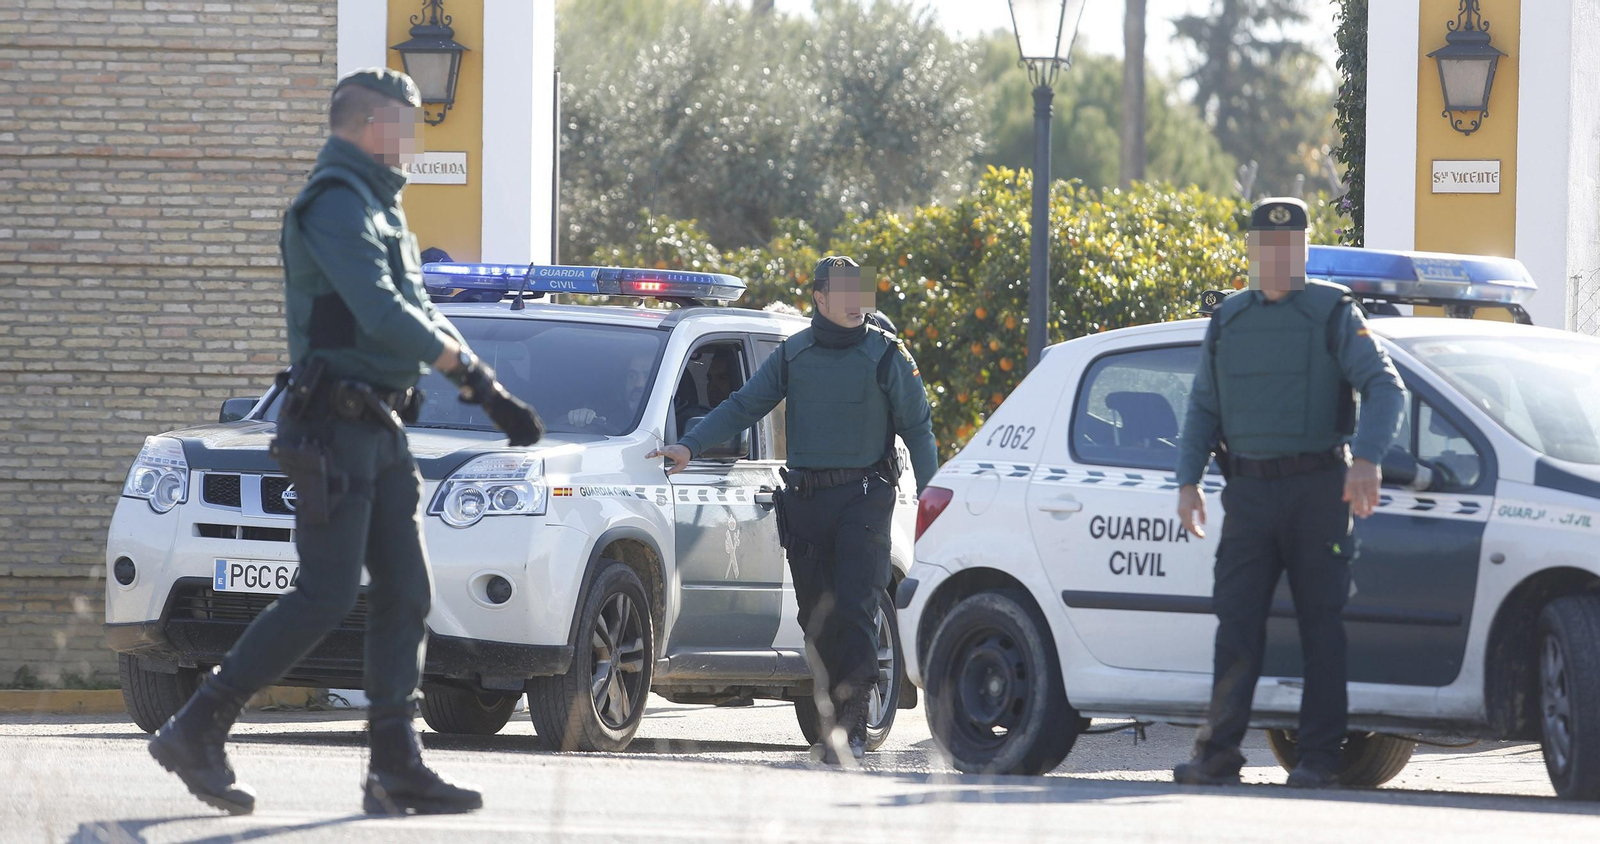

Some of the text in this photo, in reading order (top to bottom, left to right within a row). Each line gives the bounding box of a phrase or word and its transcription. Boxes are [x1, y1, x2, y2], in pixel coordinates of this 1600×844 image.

[1450, 171, 1499, 184] VICENTE
[540, 268, 585, 278] GUARDIA
[549, 280, 577, 289] CIVIL
[1000, 424, 1036, 450] 062
[580, 486, 632, 497] GUARDIA CIVIL
[1498, 504, 1556, 522] GUARDI
[1089, 514, 1191, 543] GUARDIA
[1108, 550, 1167, 577] CIVIL
